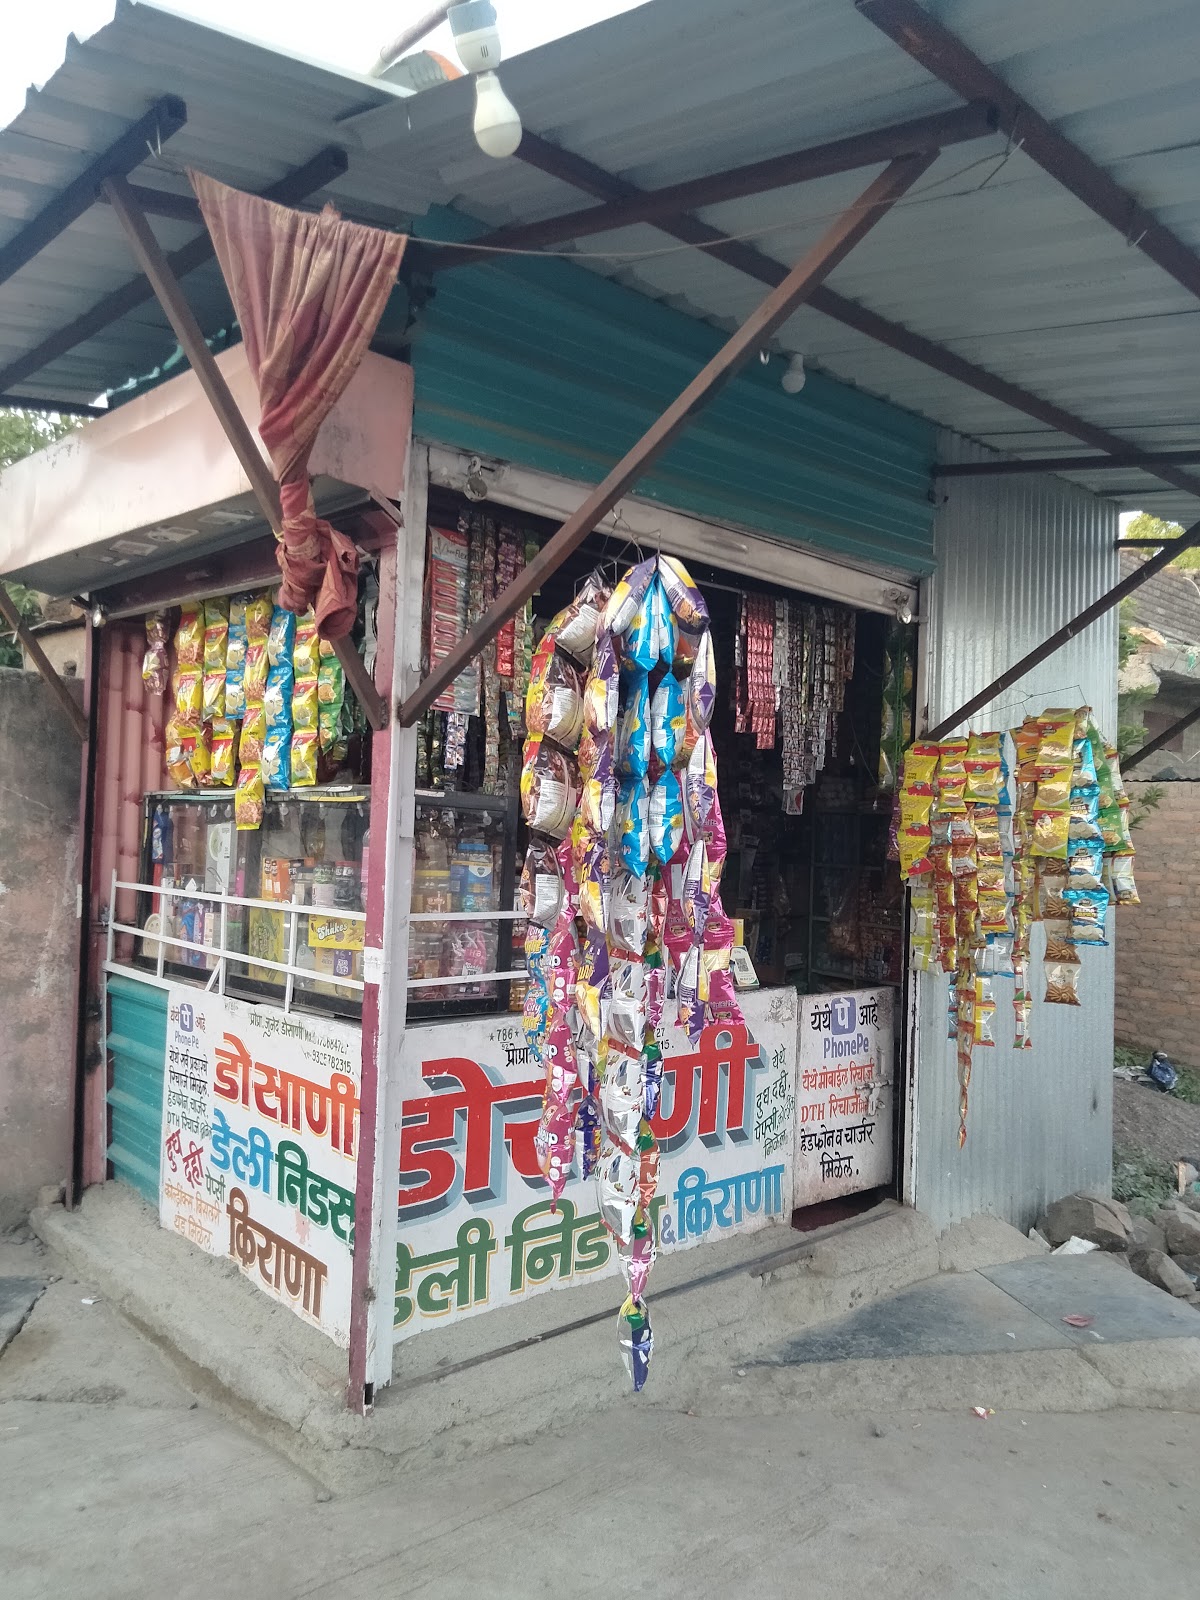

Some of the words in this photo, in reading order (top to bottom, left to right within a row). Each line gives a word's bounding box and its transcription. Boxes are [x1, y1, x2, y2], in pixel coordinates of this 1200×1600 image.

[317, 922, 348, 940] Shakes
[810, 1004, 832, 1032] येथे
[857, 996, 879, 1030] आहे
[823, 1032, 869, 1059] PhonePe
[802, 1068, 818, 1091] येथे
[849, 1057, 875, 1084] रिचार्ज
[166, 1111, 180, 1127] DTH
[801, 1102, 826, 1124] DTH
[828, 1086, 861, 1119] रिचार्ज
[844, 1117, 876, 1146] चार्जर
[210, 1107, 276, 1197] डेली
[660, 1207, 678, 1245] &
[673, 1165, 785, 1242] किराणा
[225, 1187, 328, 1321] किराणा
